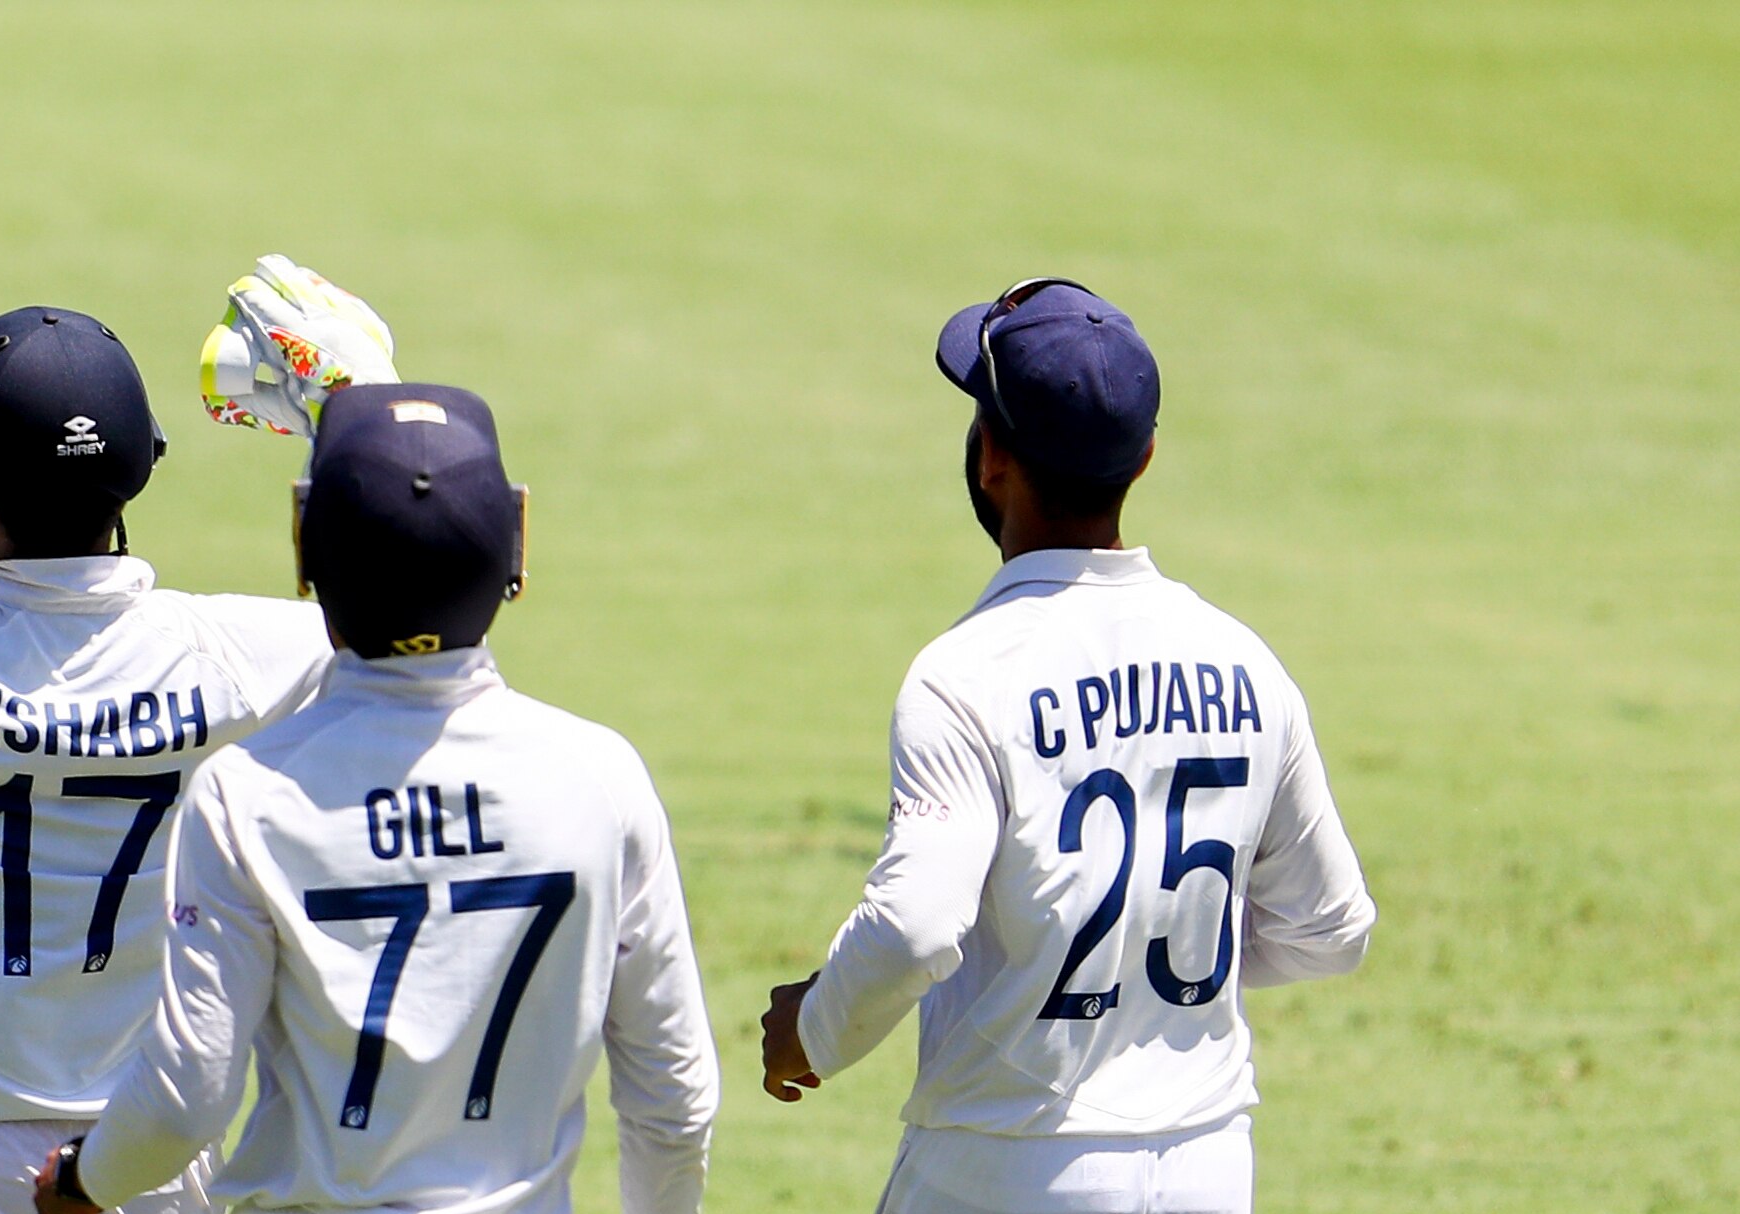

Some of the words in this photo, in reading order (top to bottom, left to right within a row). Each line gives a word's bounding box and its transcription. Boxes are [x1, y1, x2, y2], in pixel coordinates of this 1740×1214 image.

[57, 441, 106, 456] SHREY
[1030, 687, 1066, 759] C
[1076, 661, 1262, 750] PUJARA
[364, 783, 505, 860] GILL
[1037, 757, 1250, 1020] 25
[304, 872, 576, 1131] 77
